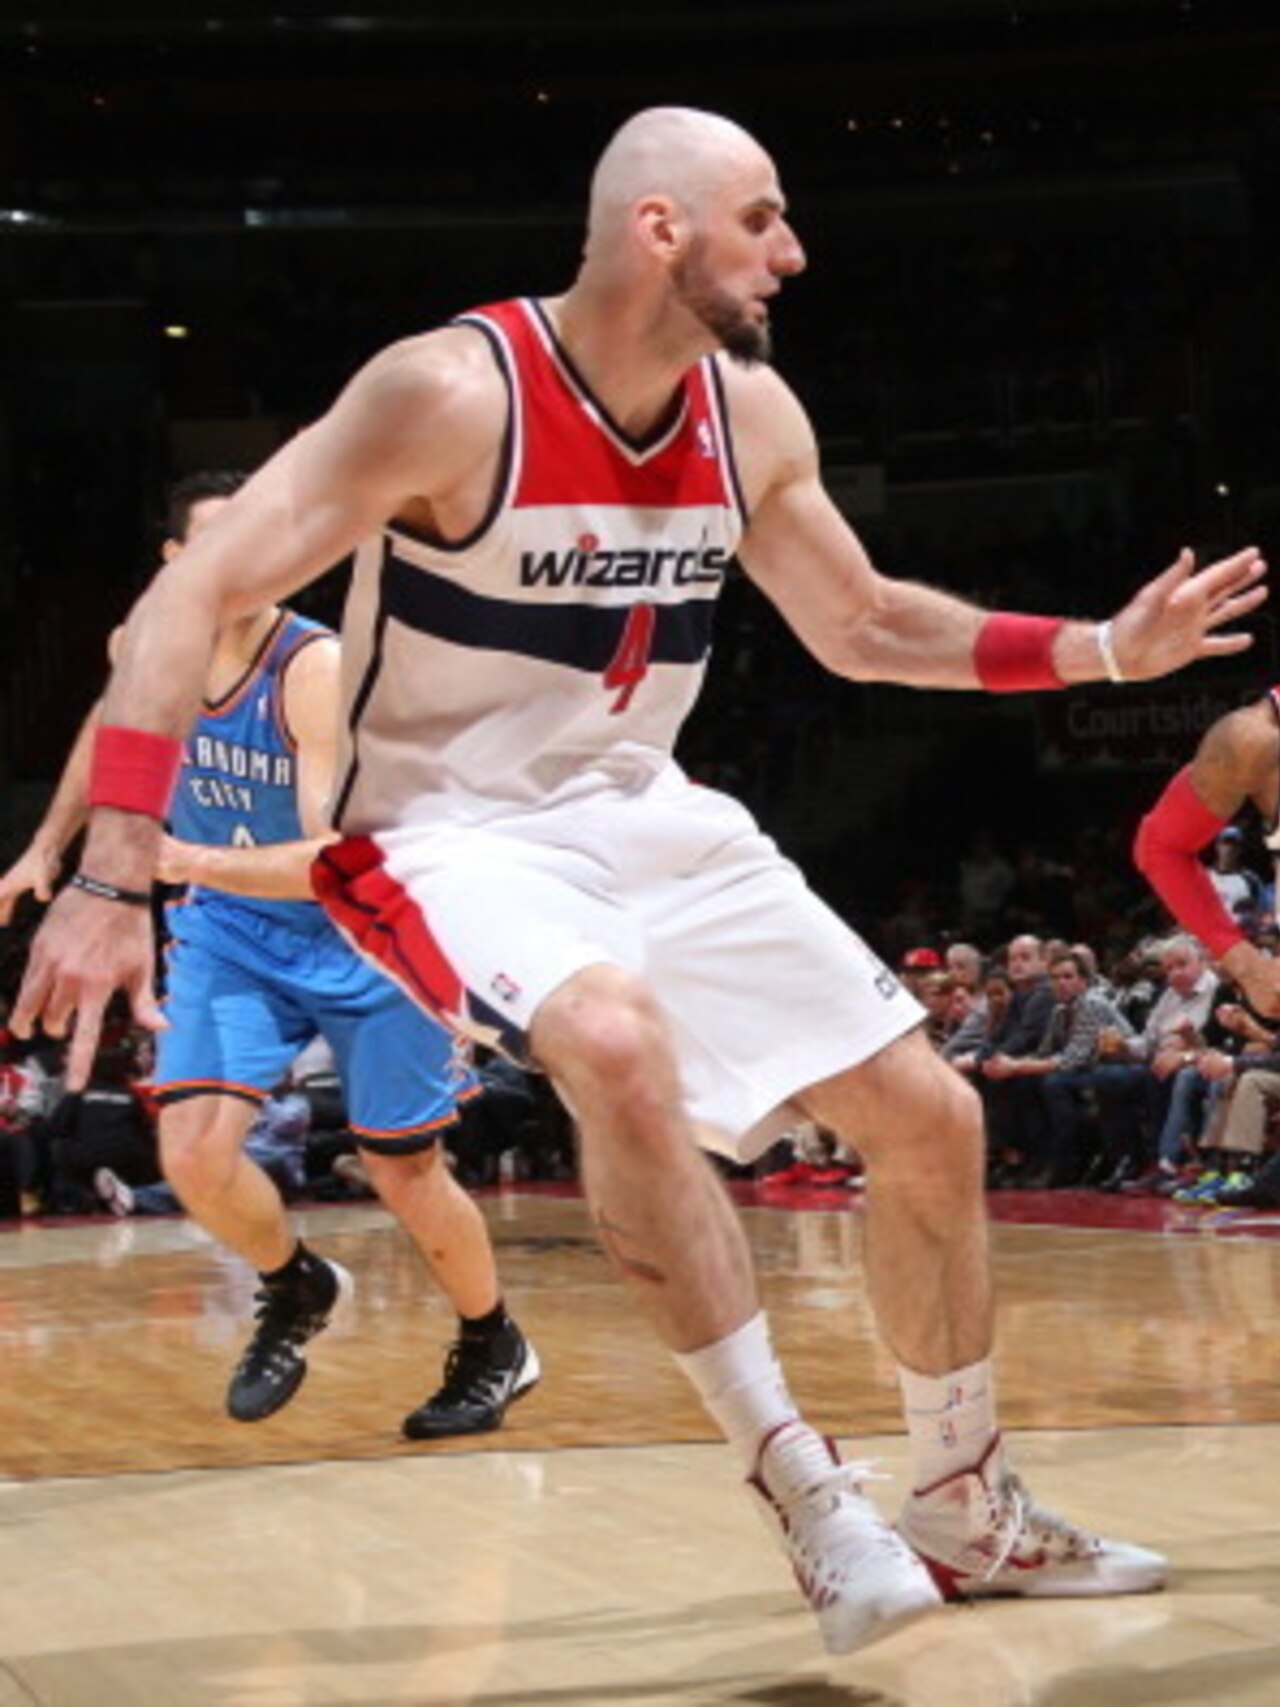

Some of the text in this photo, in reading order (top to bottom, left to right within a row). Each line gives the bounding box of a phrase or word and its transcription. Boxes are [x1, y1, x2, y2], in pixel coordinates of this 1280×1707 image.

[603, 600, 656, 716] 4
[186, 735, 291, 787] AHOMA
[189, 777, 252, 813] CITY
